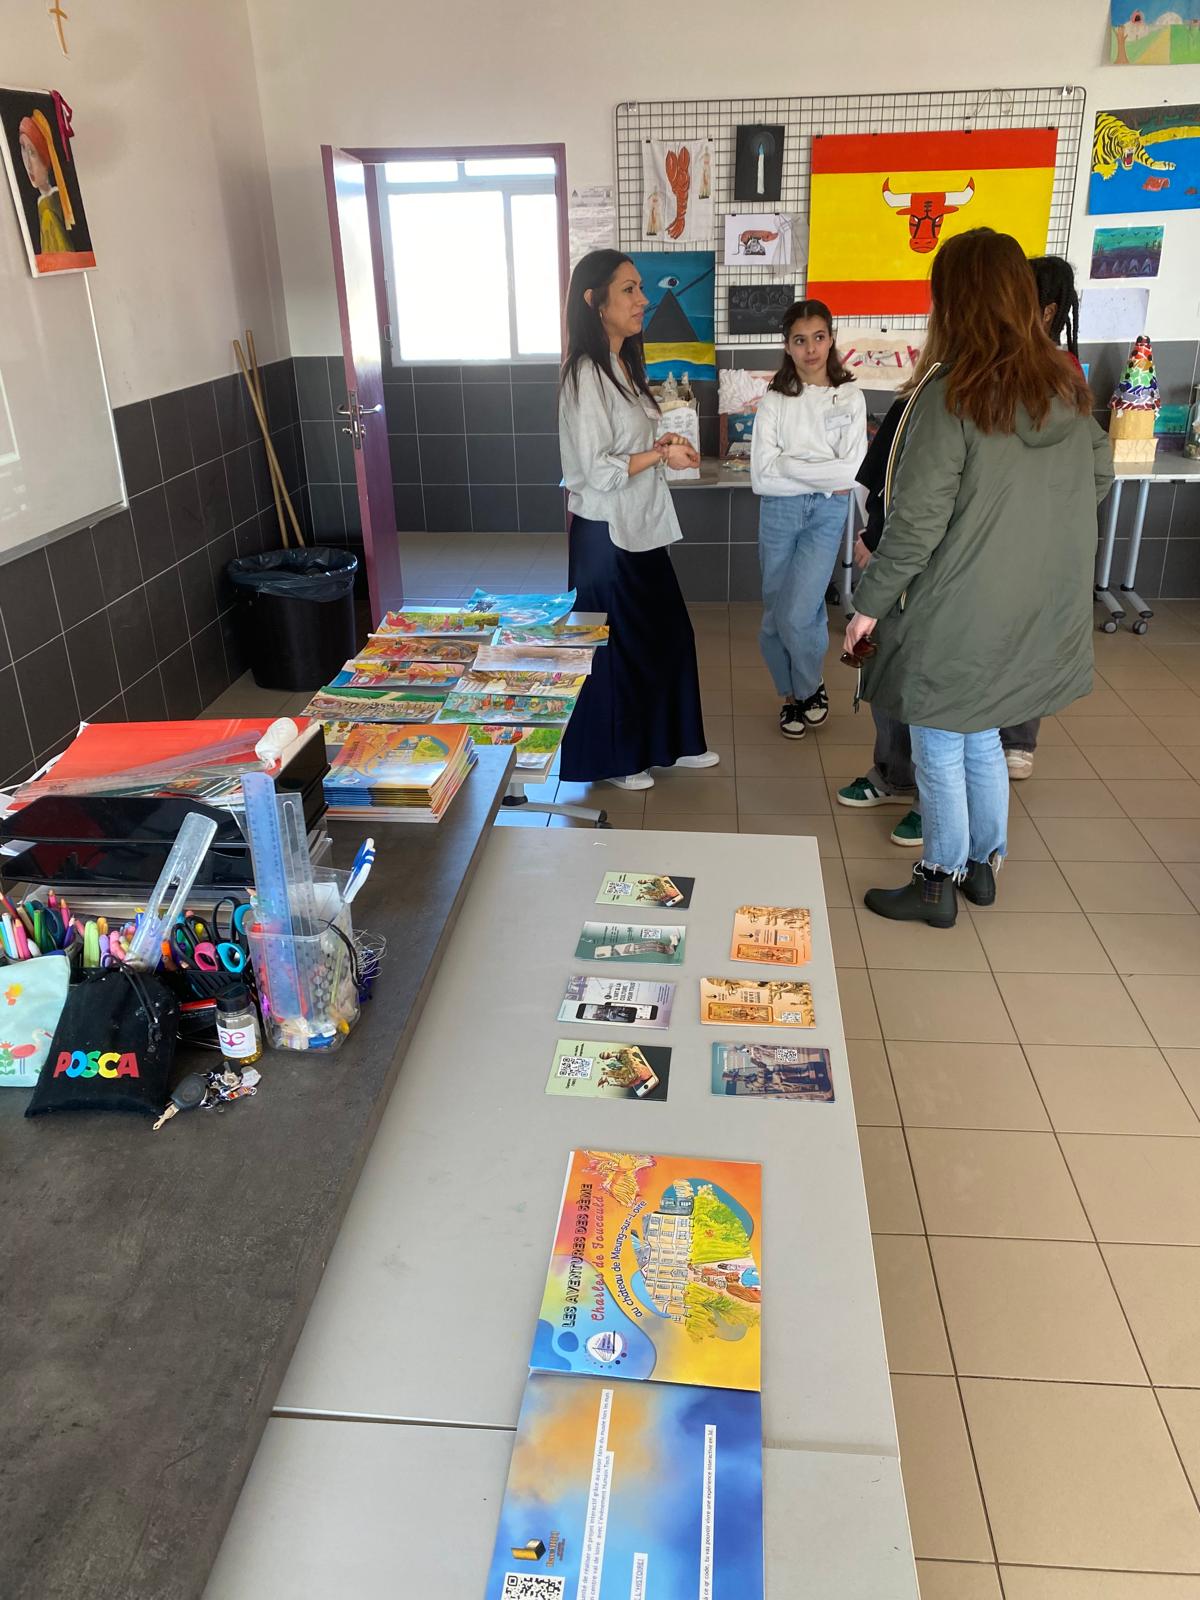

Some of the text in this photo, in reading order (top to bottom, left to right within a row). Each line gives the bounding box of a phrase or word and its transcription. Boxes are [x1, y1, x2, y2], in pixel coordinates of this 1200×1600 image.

[53, 1050, 140, 1078] POSCA
[561, 1183, 592, 1328] LES AVENTURES DES 5ÈME
[591, 1196, 605, 1321] Charles de Foucauld
[610, 1200, 648, 1318] au château de Meung-sur-Loire
[589, 1498, 598, 1524] interactif
